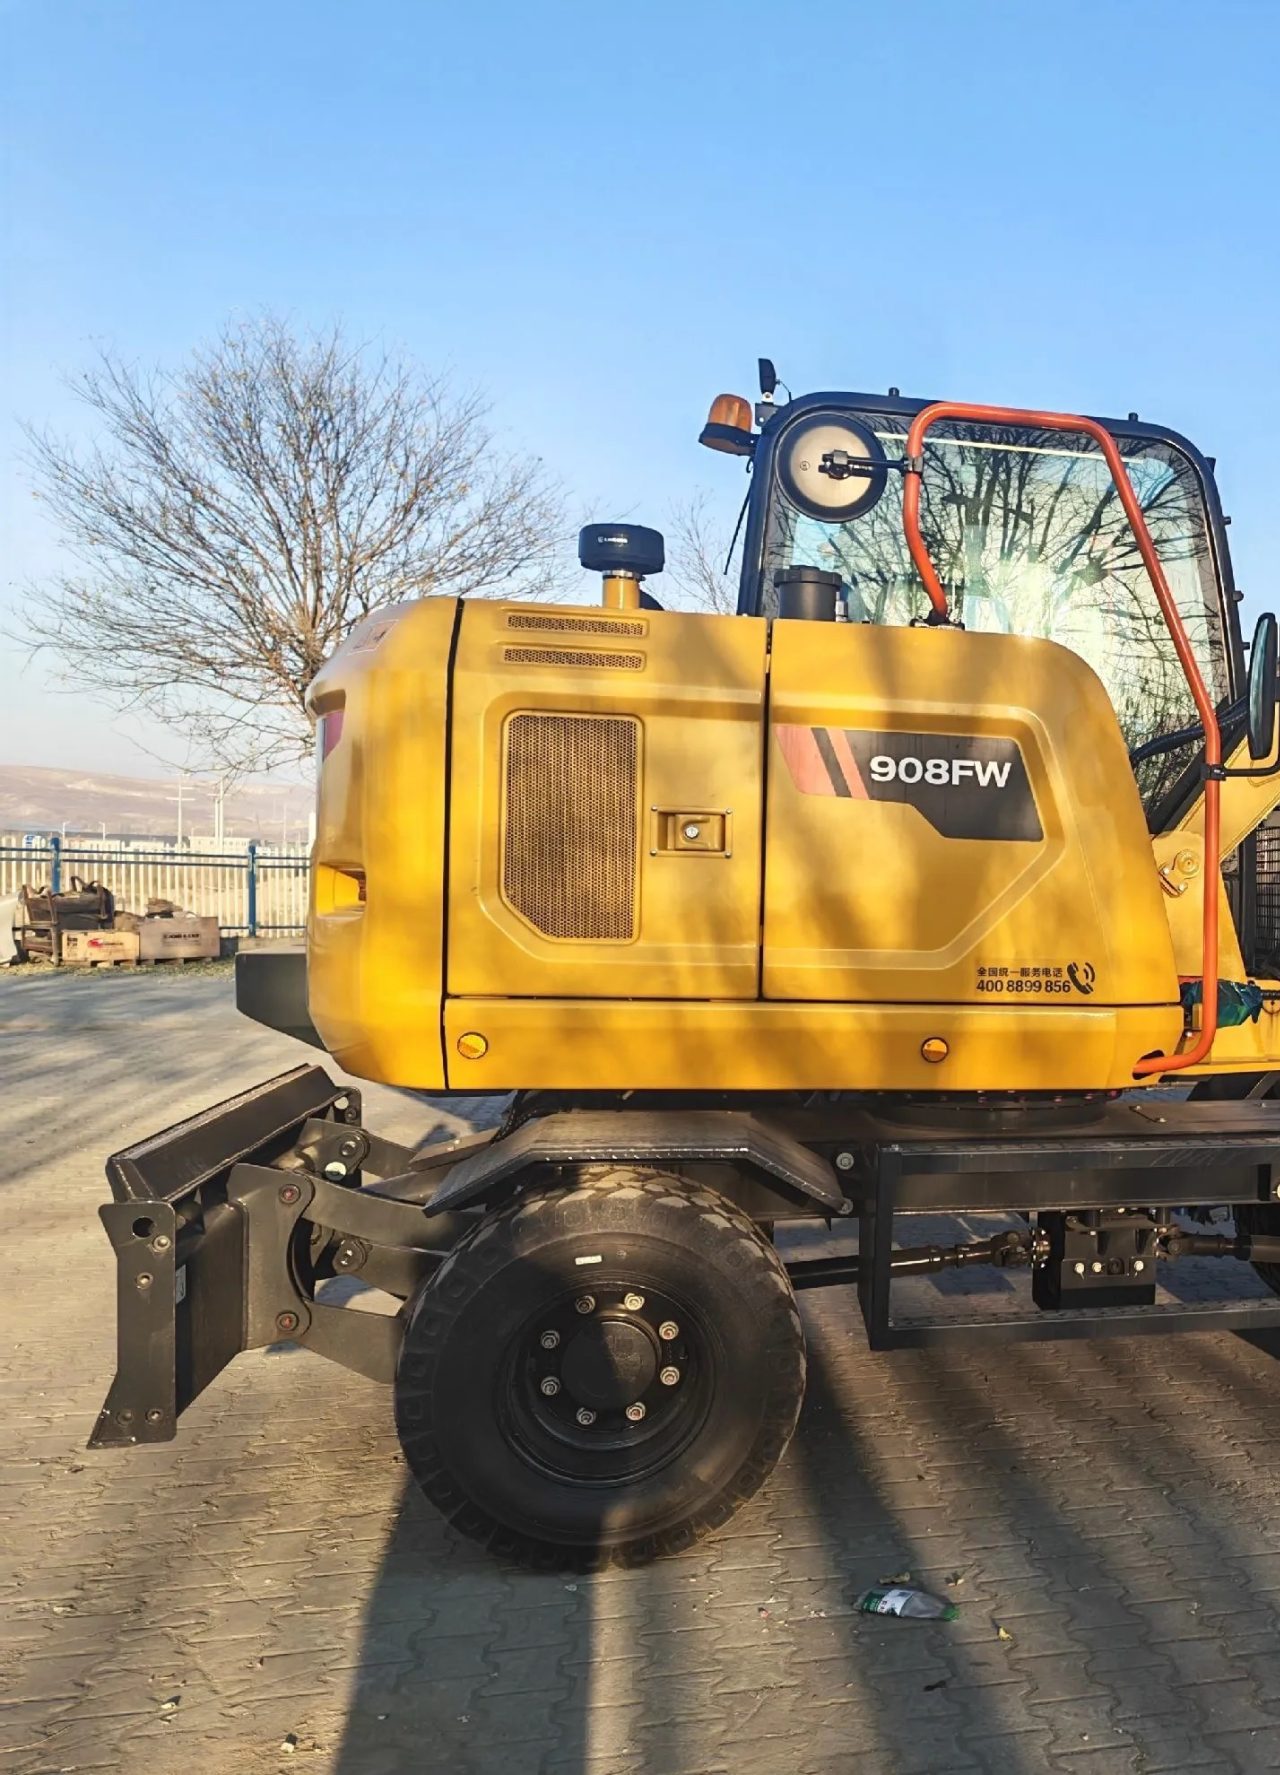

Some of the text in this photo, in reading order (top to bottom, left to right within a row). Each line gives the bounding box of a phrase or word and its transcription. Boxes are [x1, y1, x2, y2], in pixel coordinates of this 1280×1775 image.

[869, 755, 1012, 788] 908FW
[976, 966, 1063, 978] 全国统一服务电话
[976, 980, 1071, 993] 400 8899 856
